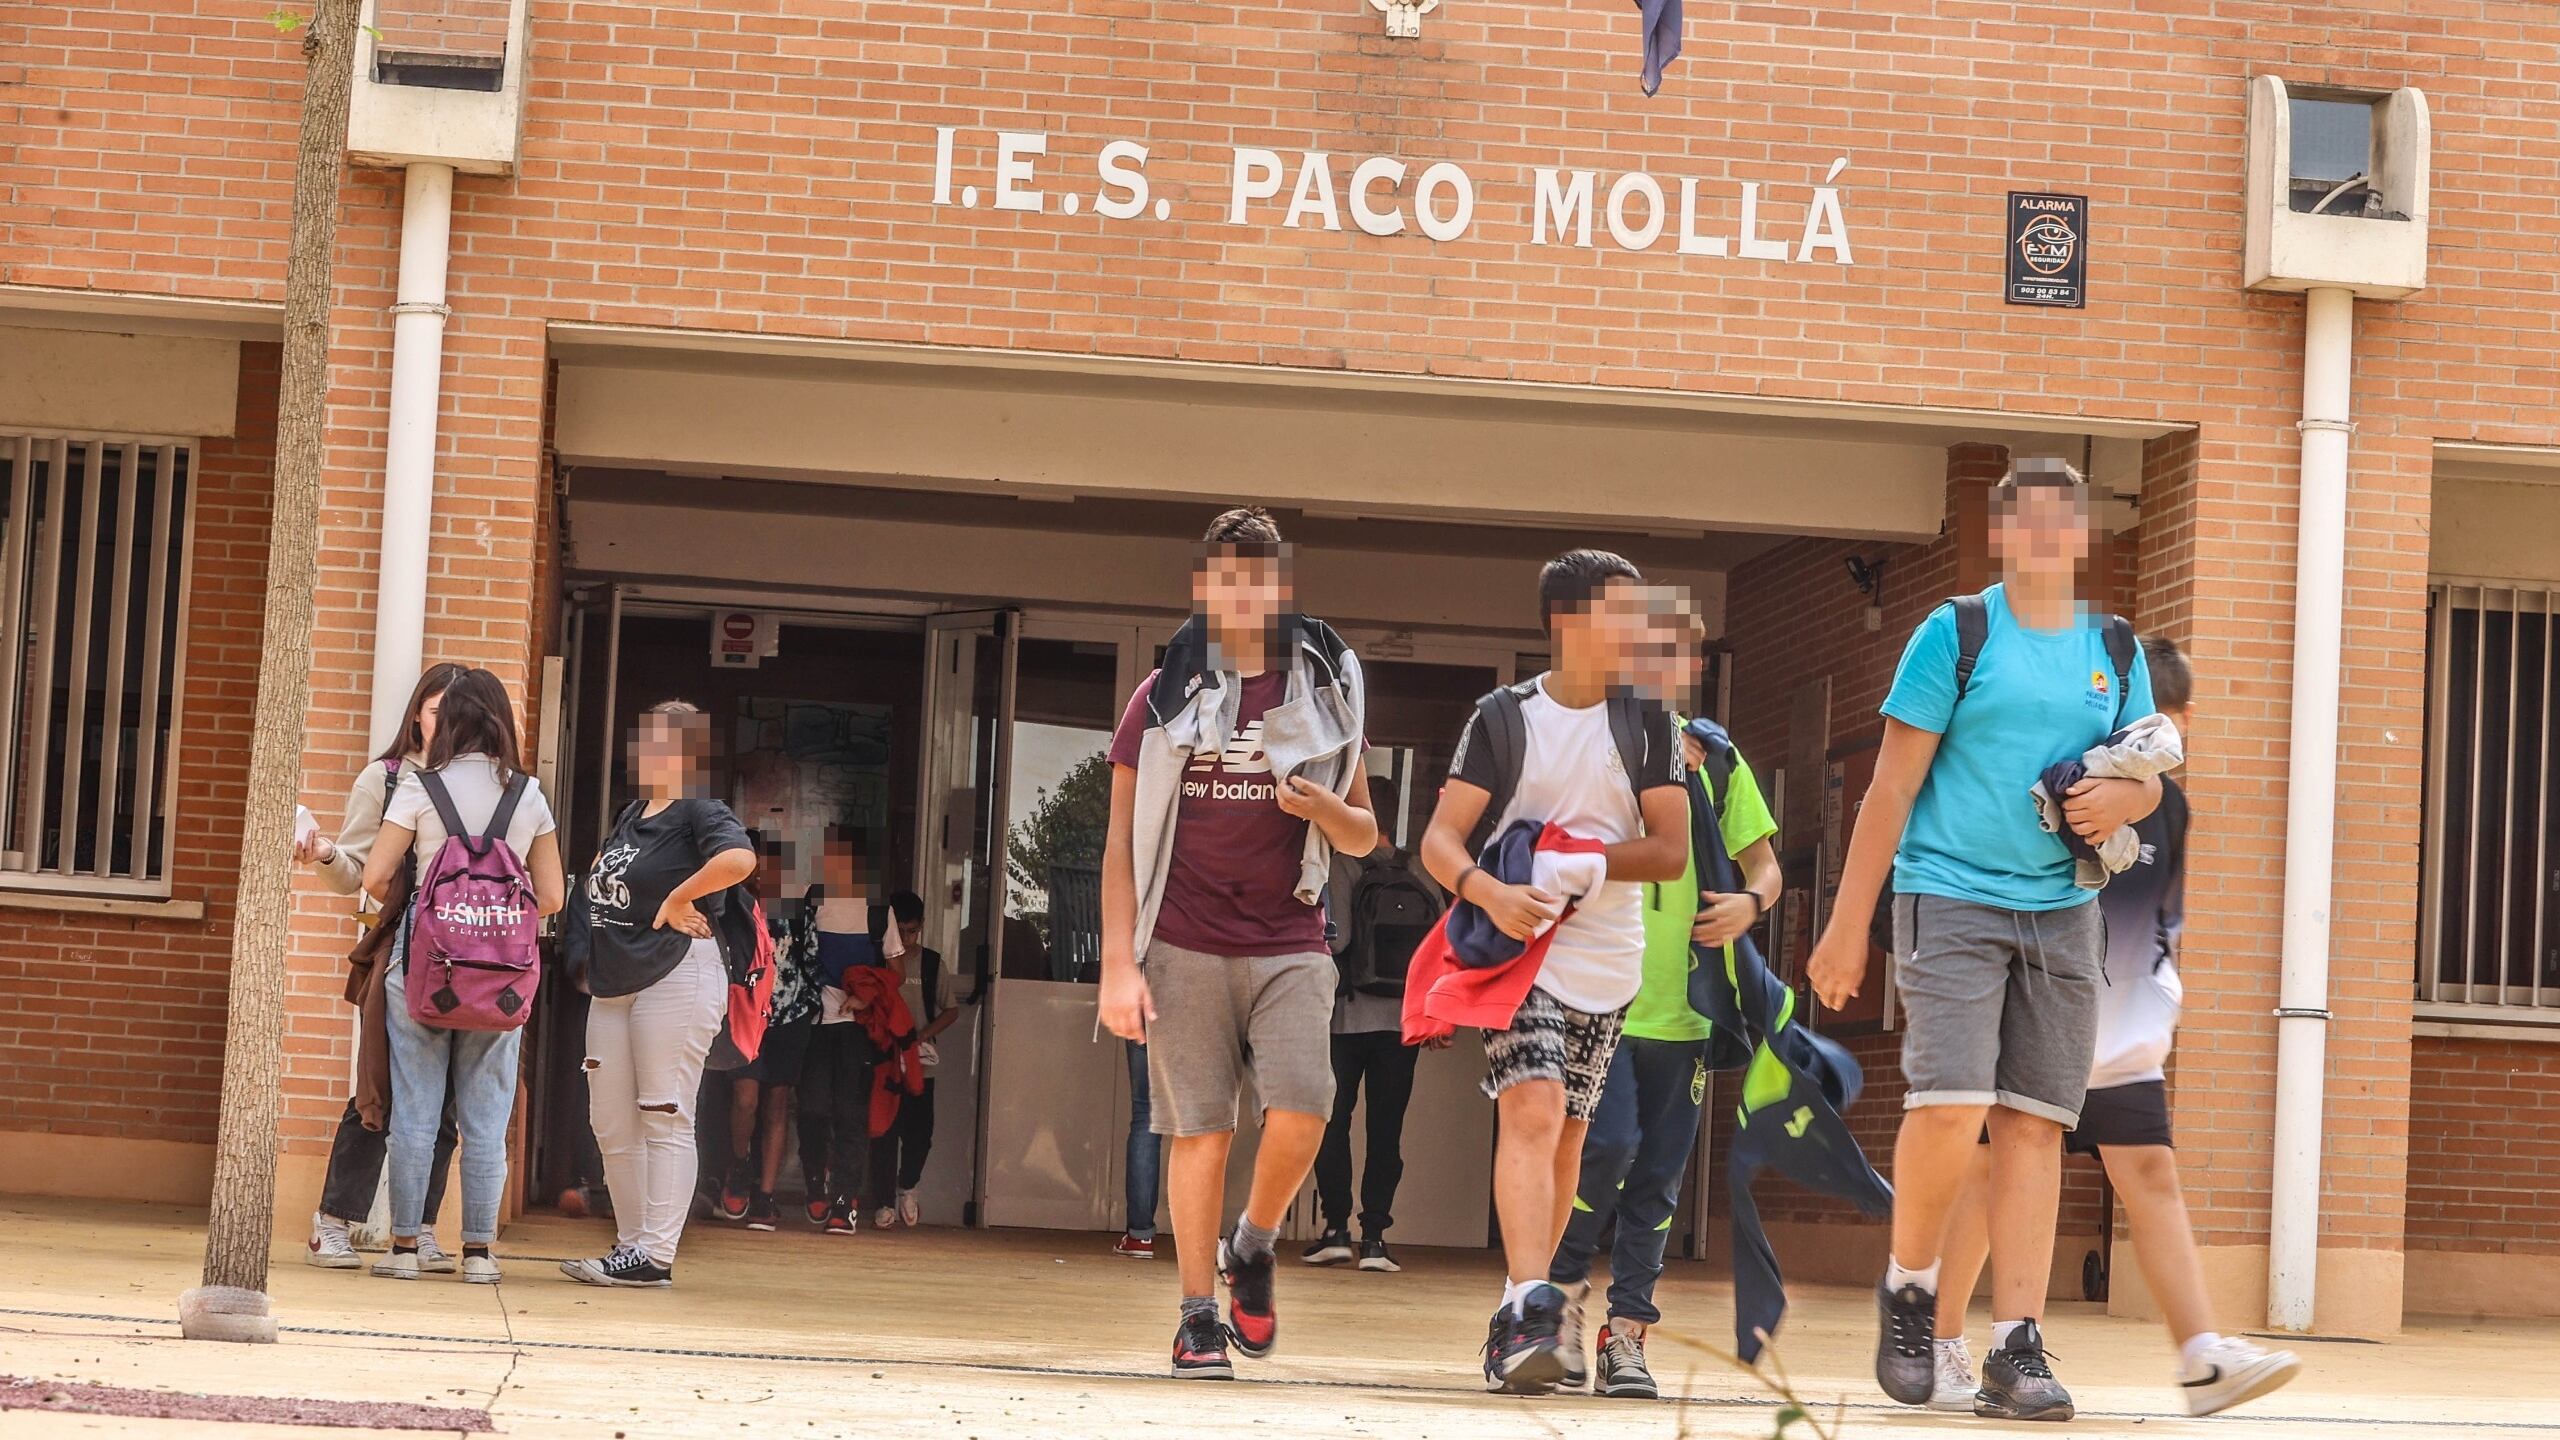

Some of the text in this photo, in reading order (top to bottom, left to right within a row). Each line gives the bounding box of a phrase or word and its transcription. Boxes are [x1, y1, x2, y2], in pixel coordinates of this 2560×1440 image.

[932, 127, 1855, 265] I.E.S. PACO MOLLÁ
[2019, 198, 2075, 212] ALARMA
[2030, 256, 2065, 264] SEGURIDAD
[2020, 286, 2035, 294] 902
[1212, 780, 1276, 800] balan
[436, 902, 522, 927] J.SMITH
